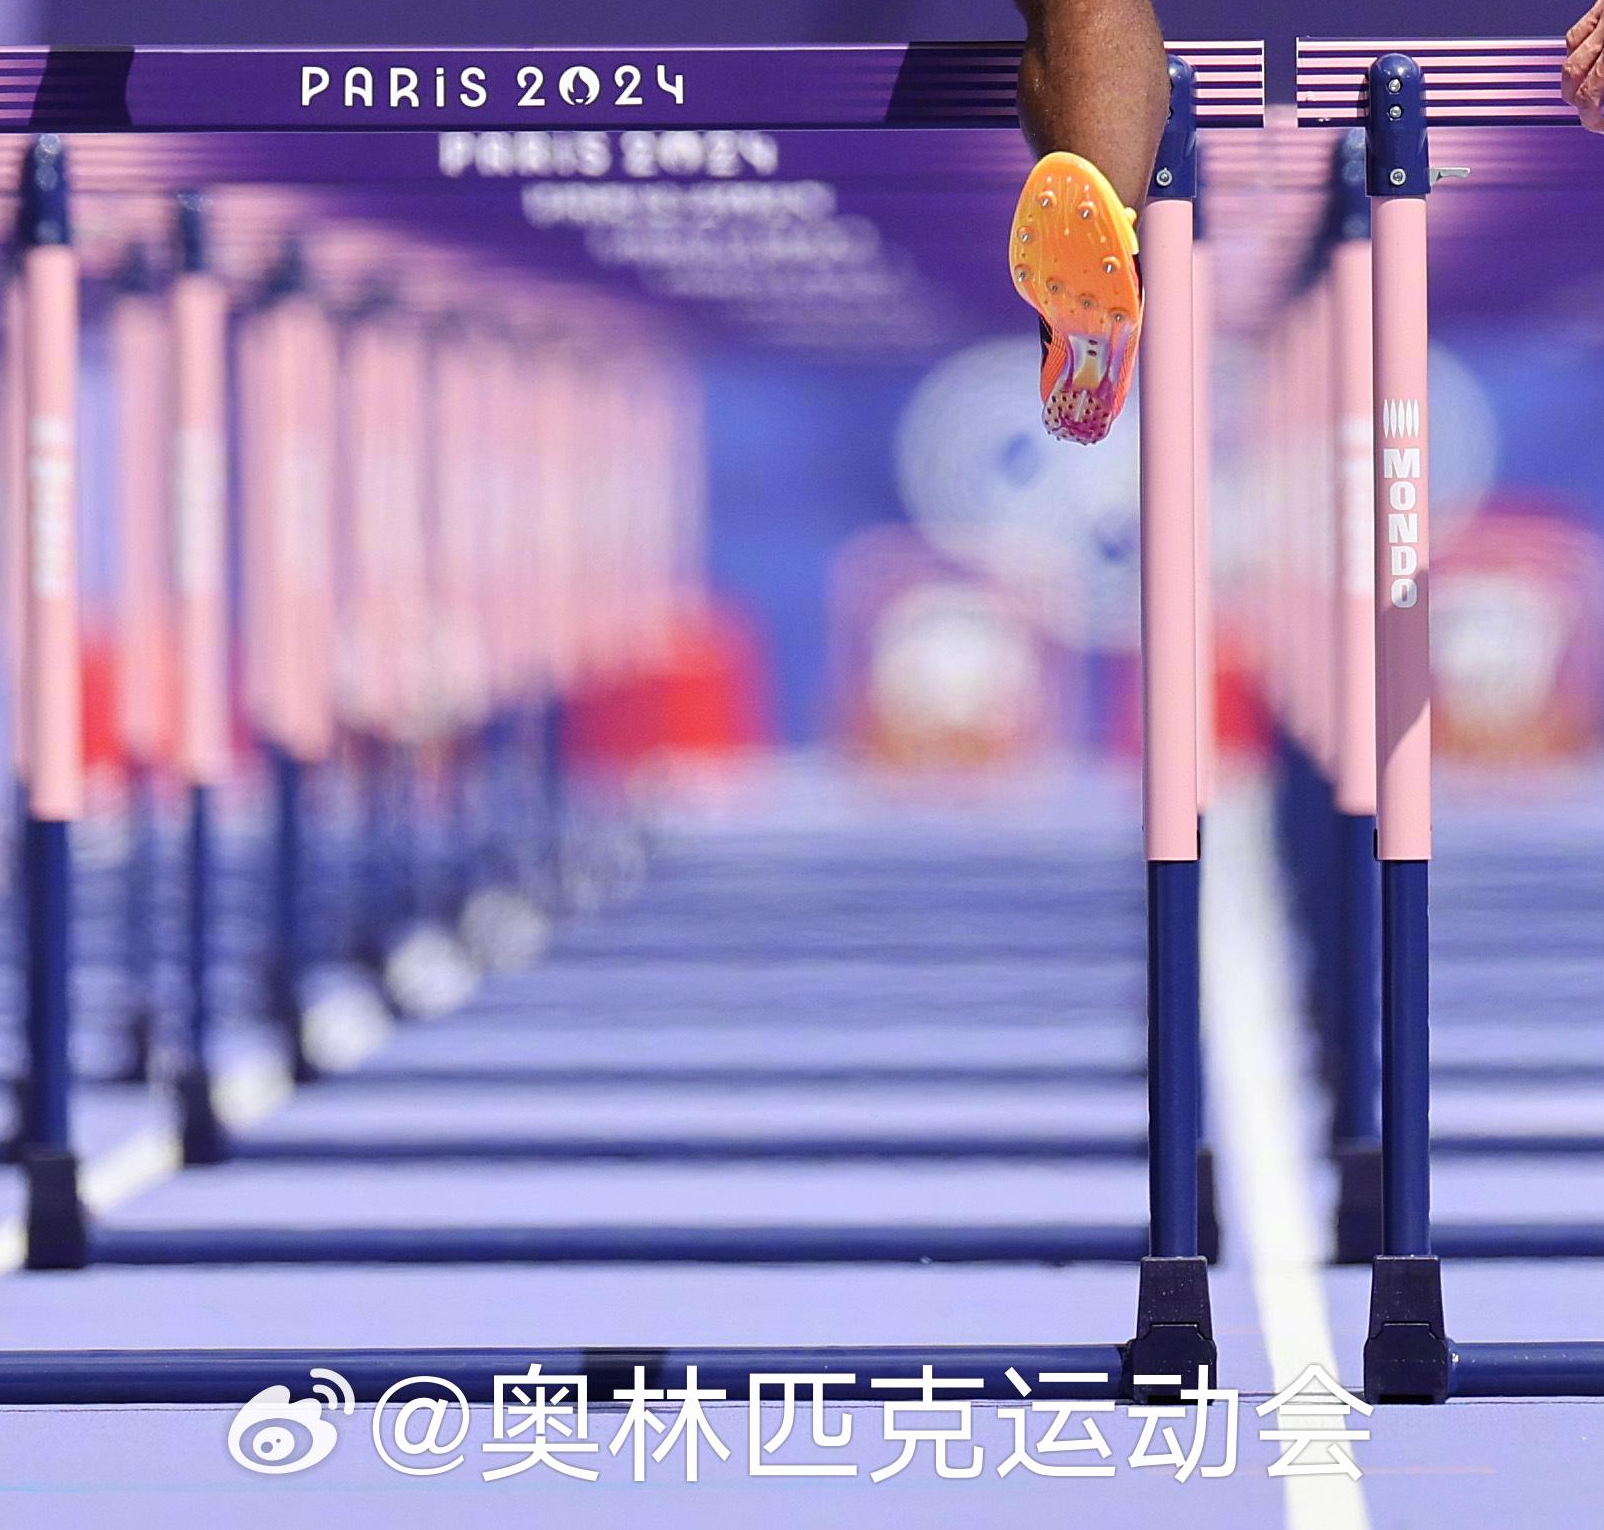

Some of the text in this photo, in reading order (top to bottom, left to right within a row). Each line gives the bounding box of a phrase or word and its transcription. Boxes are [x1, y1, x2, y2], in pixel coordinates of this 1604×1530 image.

[300, 65, 684, 107] PARIS 2024
[1383, 448, 1420, 608] MONDO
